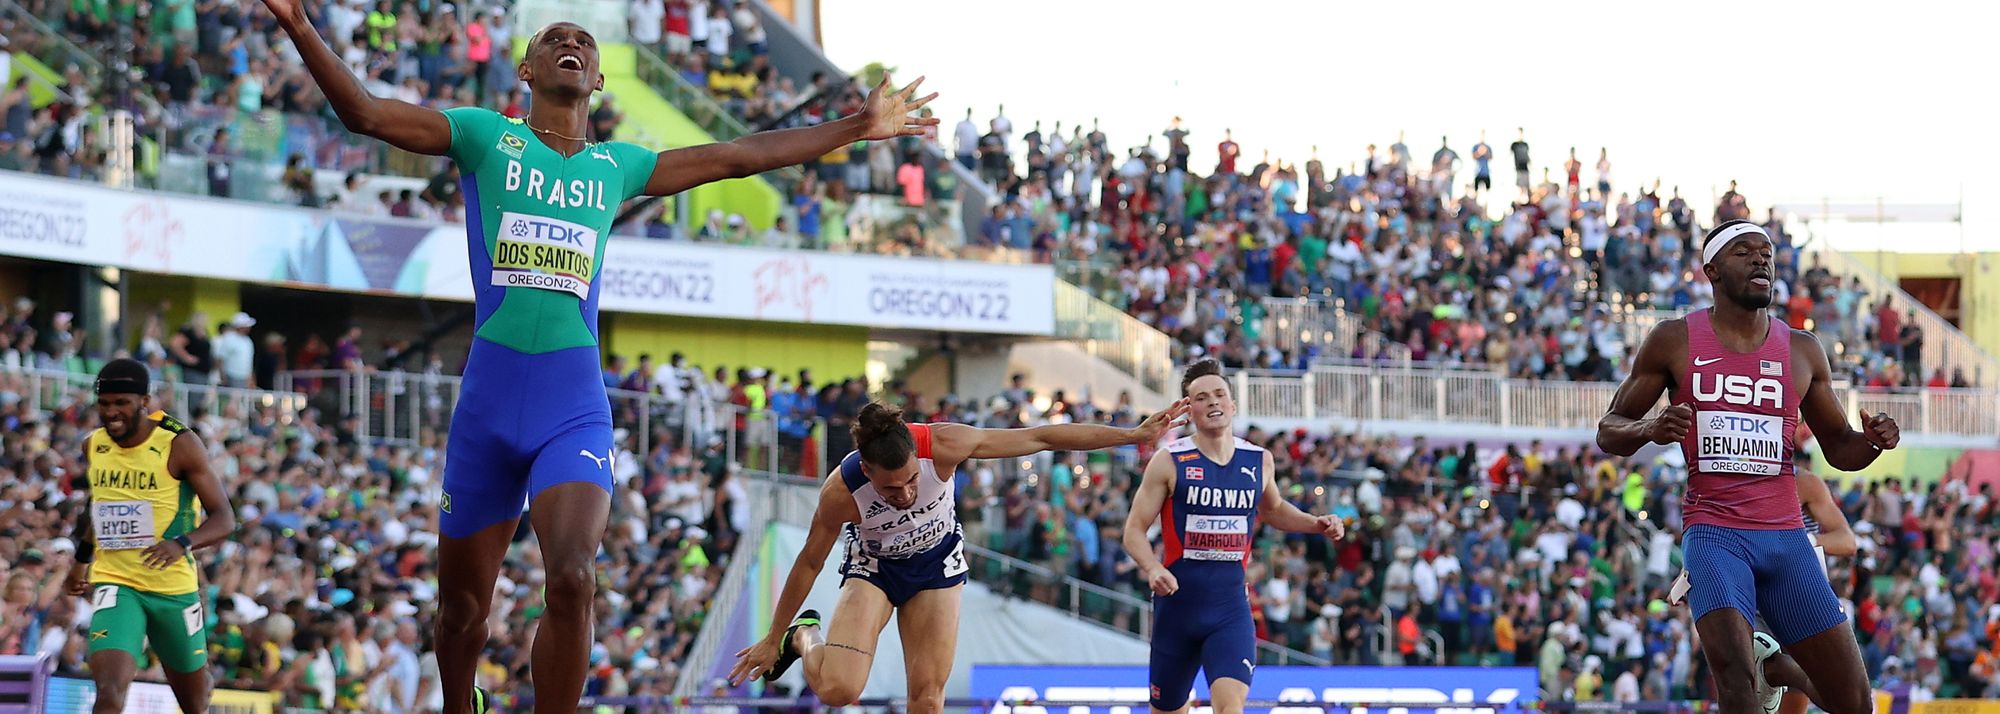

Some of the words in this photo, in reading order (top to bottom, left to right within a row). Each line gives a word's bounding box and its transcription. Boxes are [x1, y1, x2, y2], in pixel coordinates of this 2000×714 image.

[505, 160, 607, 211] BRASIL
[0, 208, 87, 247] REGON22
[529, 221, 585, 247] TDK
[498, 242, 530, 265] DOS
[533, 243, 590, 278] SANTOS
[507, 273, 579, 292] OREGON22
[603, 268, 714, 303] REGON22
[869, 288, 1010, 321] OREGON22
[1692, 372, 1783, 409] USA
[1725, 416, 1770, 435] TDK
[1703, 436, 1778, 459] BENJAMIN
[1711, 462, 1768, 474] OREGON22
[93, 470, 158, 490] JAMAICA
[1186, 486, 1255, 509] NORWAY
[107, 504, 142, 517] TDK
[865, 506, 890, 520] adidas
[102, 520, 140, 535] HYDE
[905, 514, 940, 539] TDK
[1207, 519, 1239, 530] TDK
[889, 520, 945, 552] HAPPIO
[1190, 532, 1245, 547] WARHOLM
[1194, 551, 1239, 560] OREGON22
[191, 608, 204, 627] 7
